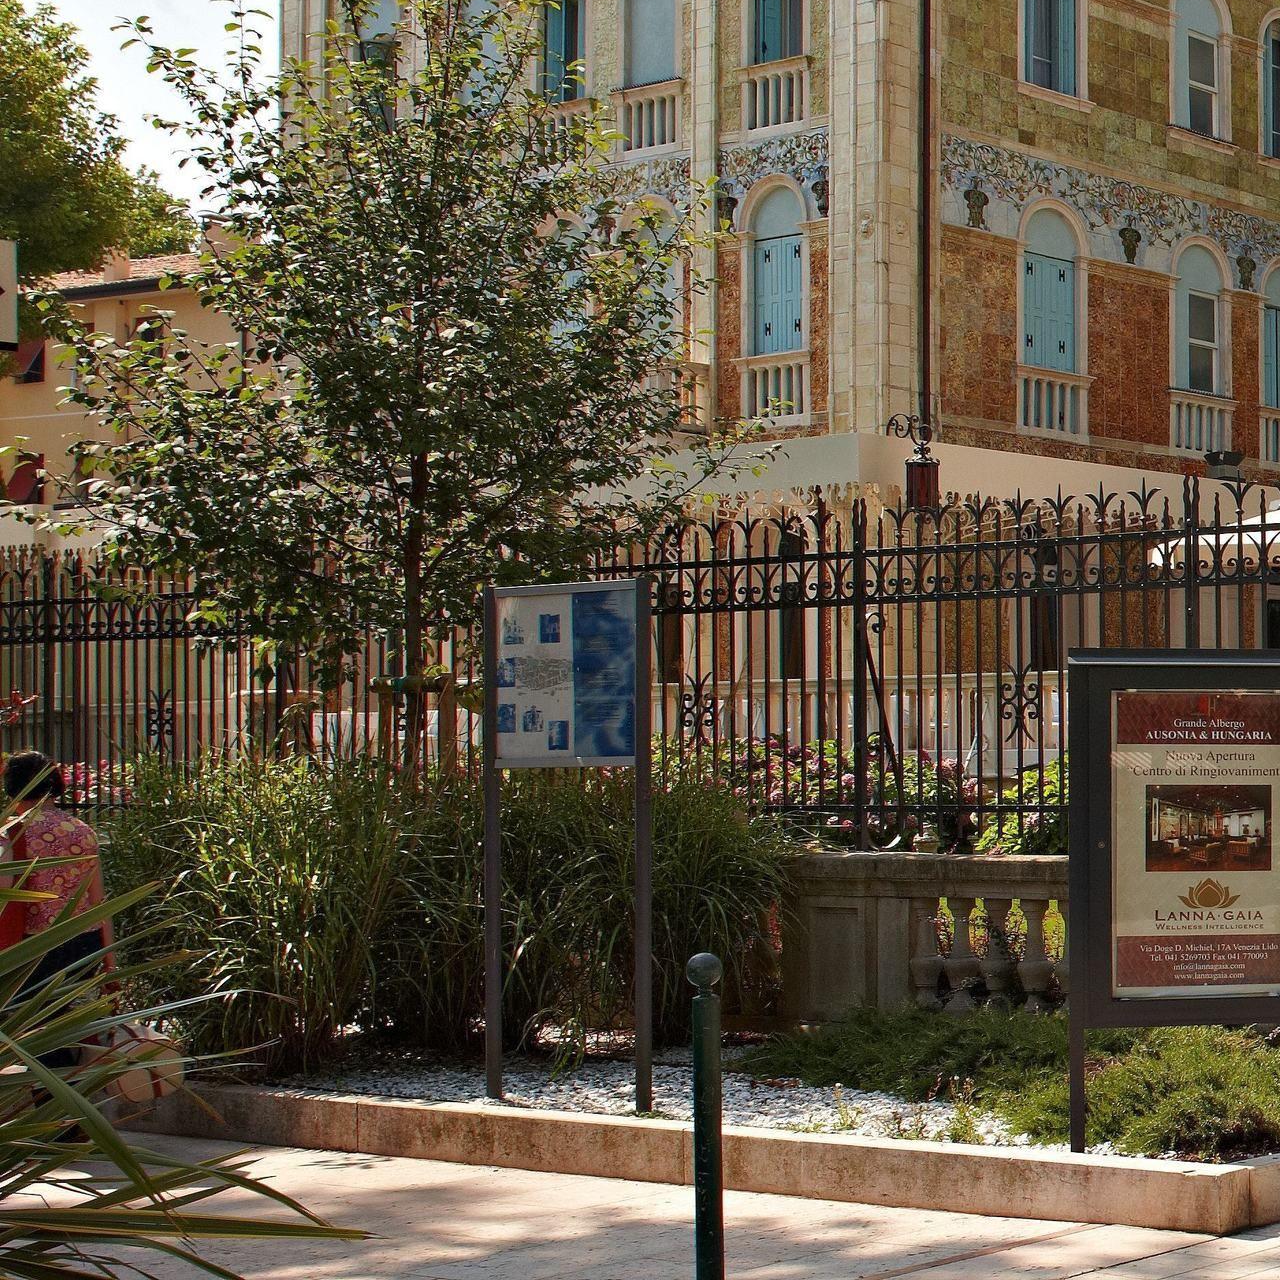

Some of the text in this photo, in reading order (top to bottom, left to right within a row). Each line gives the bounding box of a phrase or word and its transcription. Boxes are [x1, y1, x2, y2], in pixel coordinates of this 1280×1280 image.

[1173, 718, 1245, 730] Grande Albergo
[1146, 730, 1272, 740] AUSONIA & HUNGARIA
[1165, 750, 1255, 764] Nuova Apertura
[1175, 765, 1187, 777] di
[1154, 944, 1174, 954] Doge
[1175, 944, 1184, 952] D.
[1217, 943, 1232, 951] 17A
[1233, 943, 1260, 951] Venezia
[1262, 942, 1279, 950] Lido
[1150, 954, 1163, 962] Tel.
[1212, 953, 1226, 961] Fax
[1227, 952, 1240, 960] 041
